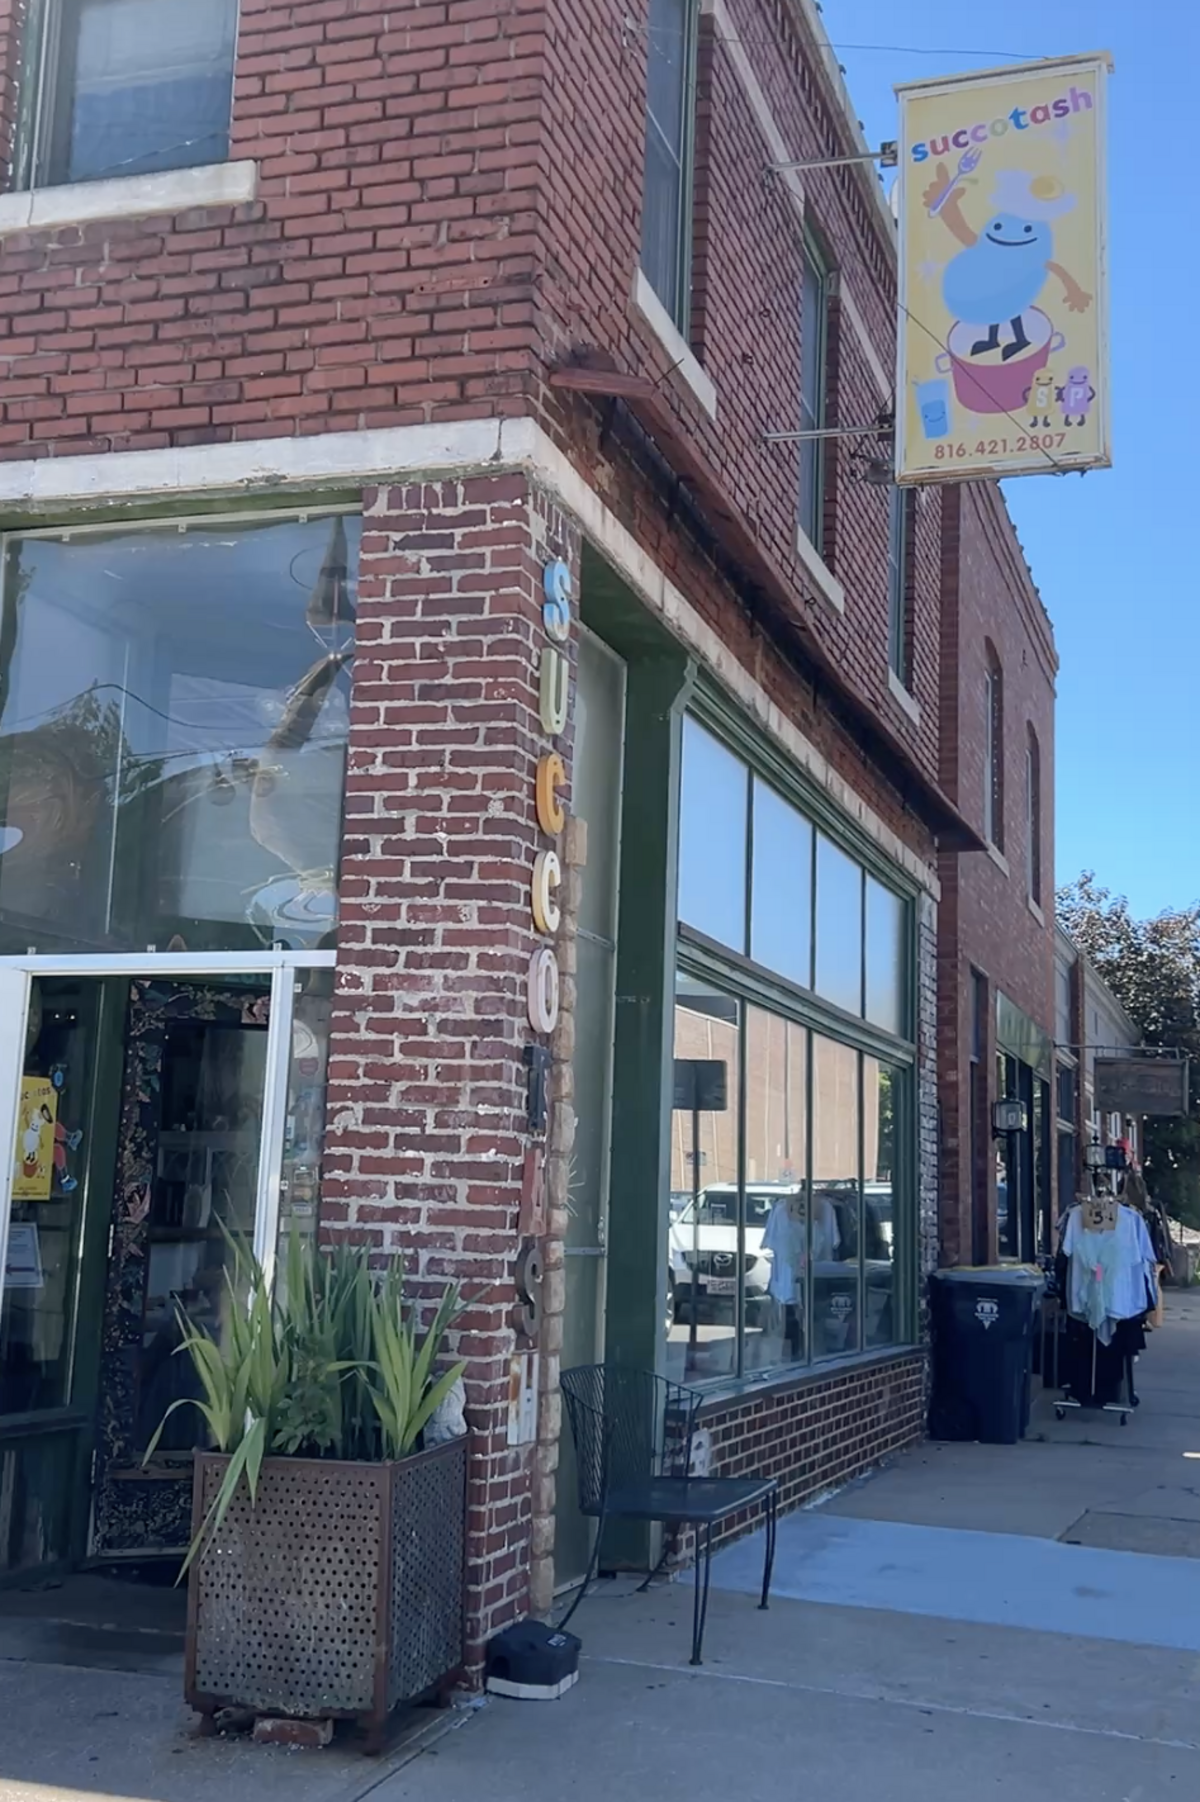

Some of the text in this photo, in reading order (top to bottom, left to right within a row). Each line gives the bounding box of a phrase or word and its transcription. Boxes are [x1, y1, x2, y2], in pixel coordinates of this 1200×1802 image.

[911, 87, 1093, 162] succotash
[1036, 386, 1048, 408] S
[1069, 387, 1084, 408] P
[934, 432, 1066, 460] 816.421.2807
